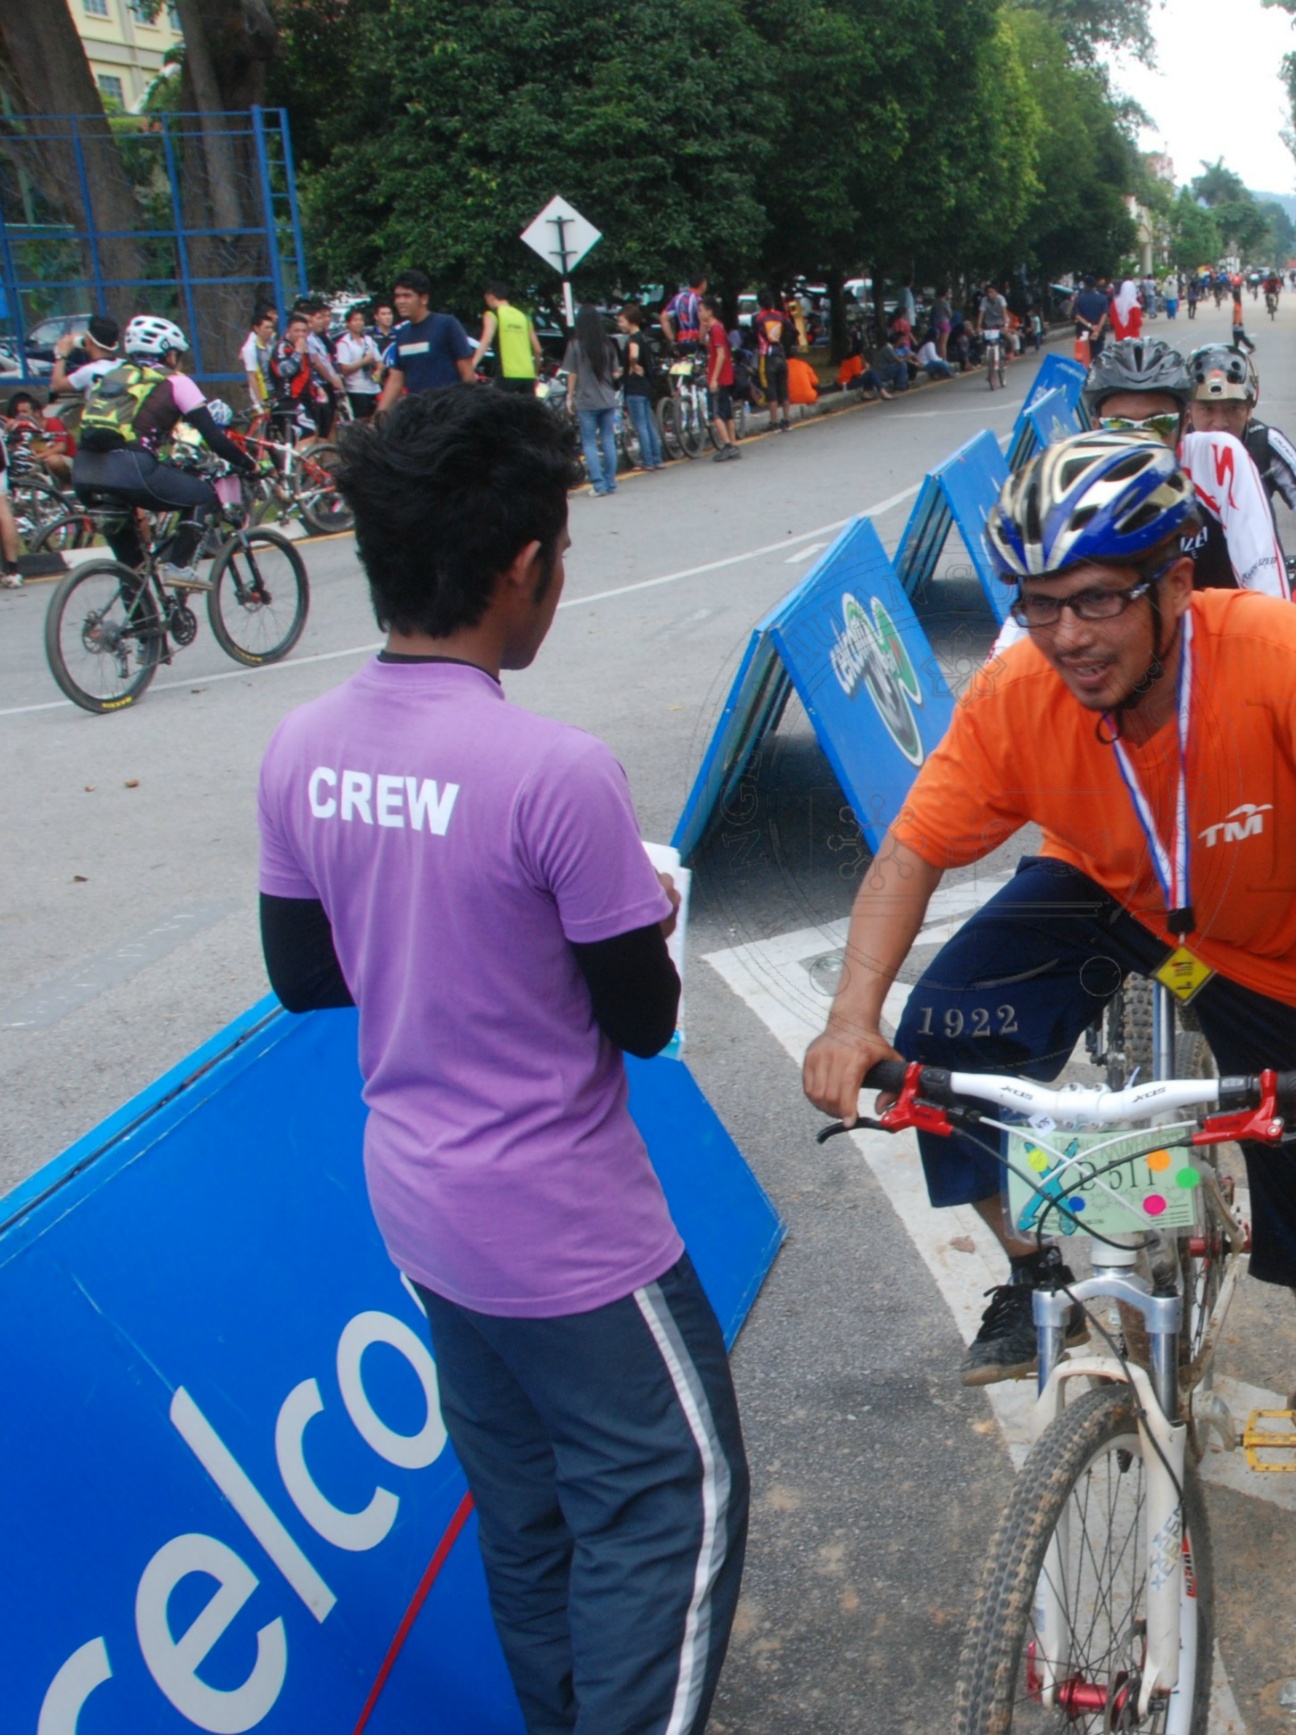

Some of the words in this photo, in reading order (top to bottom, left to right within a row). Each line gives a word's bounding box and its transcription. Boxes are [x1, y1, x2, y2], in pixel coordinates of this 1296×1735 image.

[308, 765, 460, 836] CREW
[1197, 809, 1266, 848] TM
[38, 1271, 448, 1735] celco
